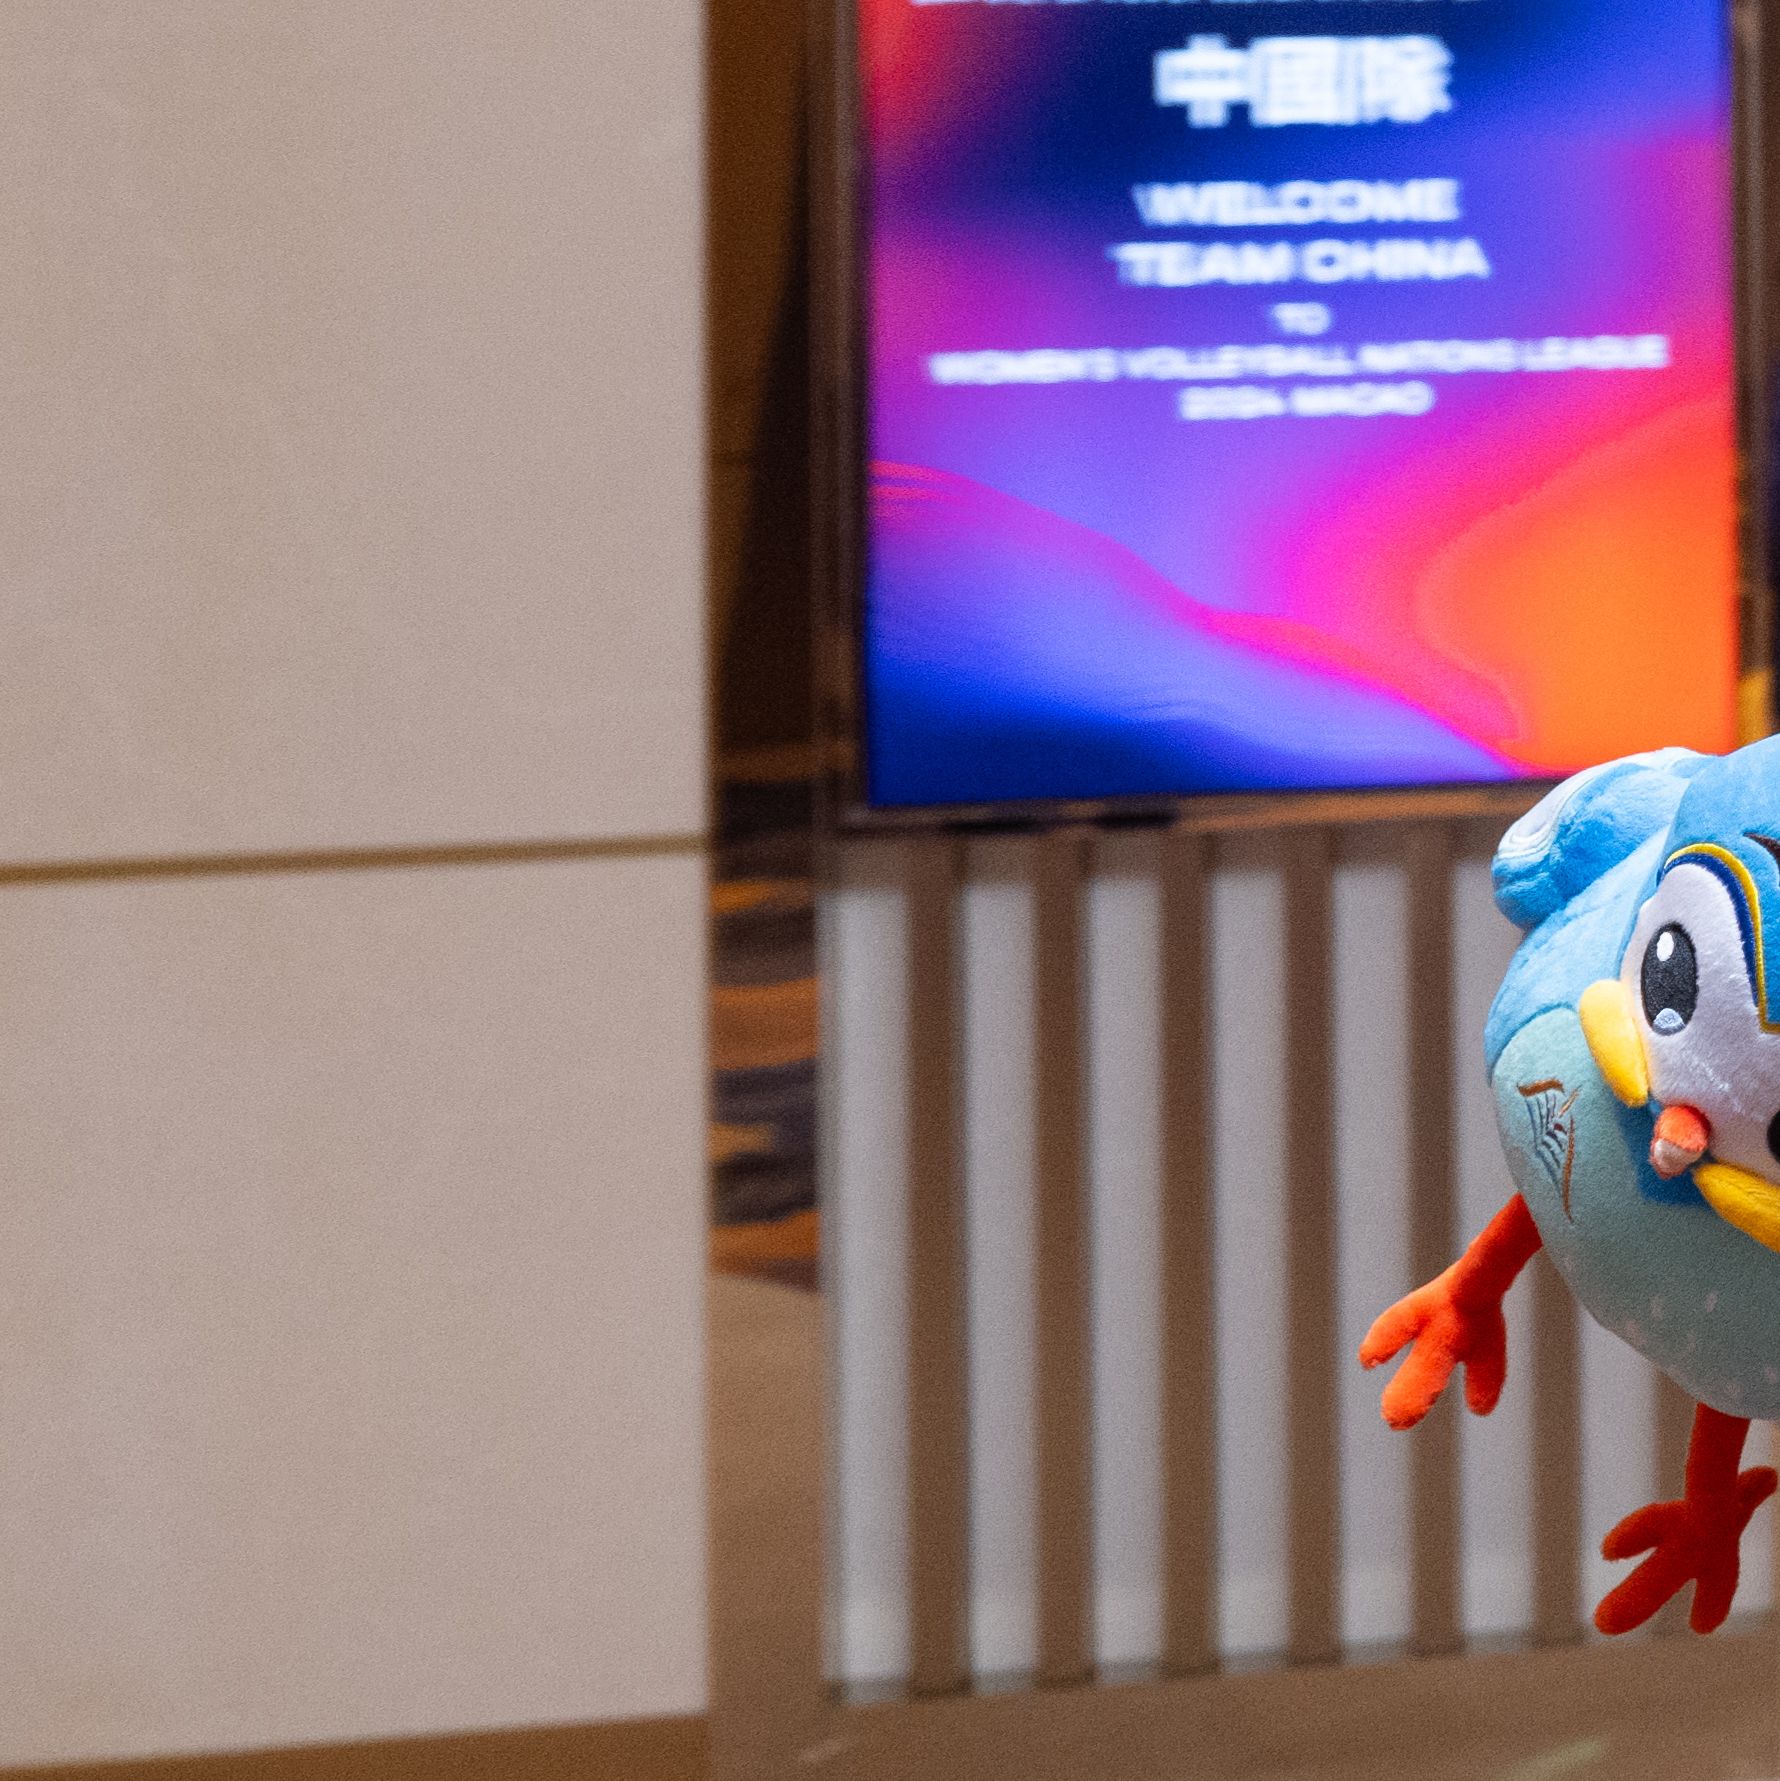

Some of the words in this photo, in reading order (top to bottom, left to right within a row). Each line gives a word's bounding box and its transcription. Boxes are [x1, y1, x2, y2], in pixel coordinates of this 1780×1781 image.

[1155, 35, 1451, 126] 中國隊
[1136, 178, 1460, 226] WELCOME
[1112, 242, 1293, 287] TEAM
[1301, 238, 1490, 283] CHINA
